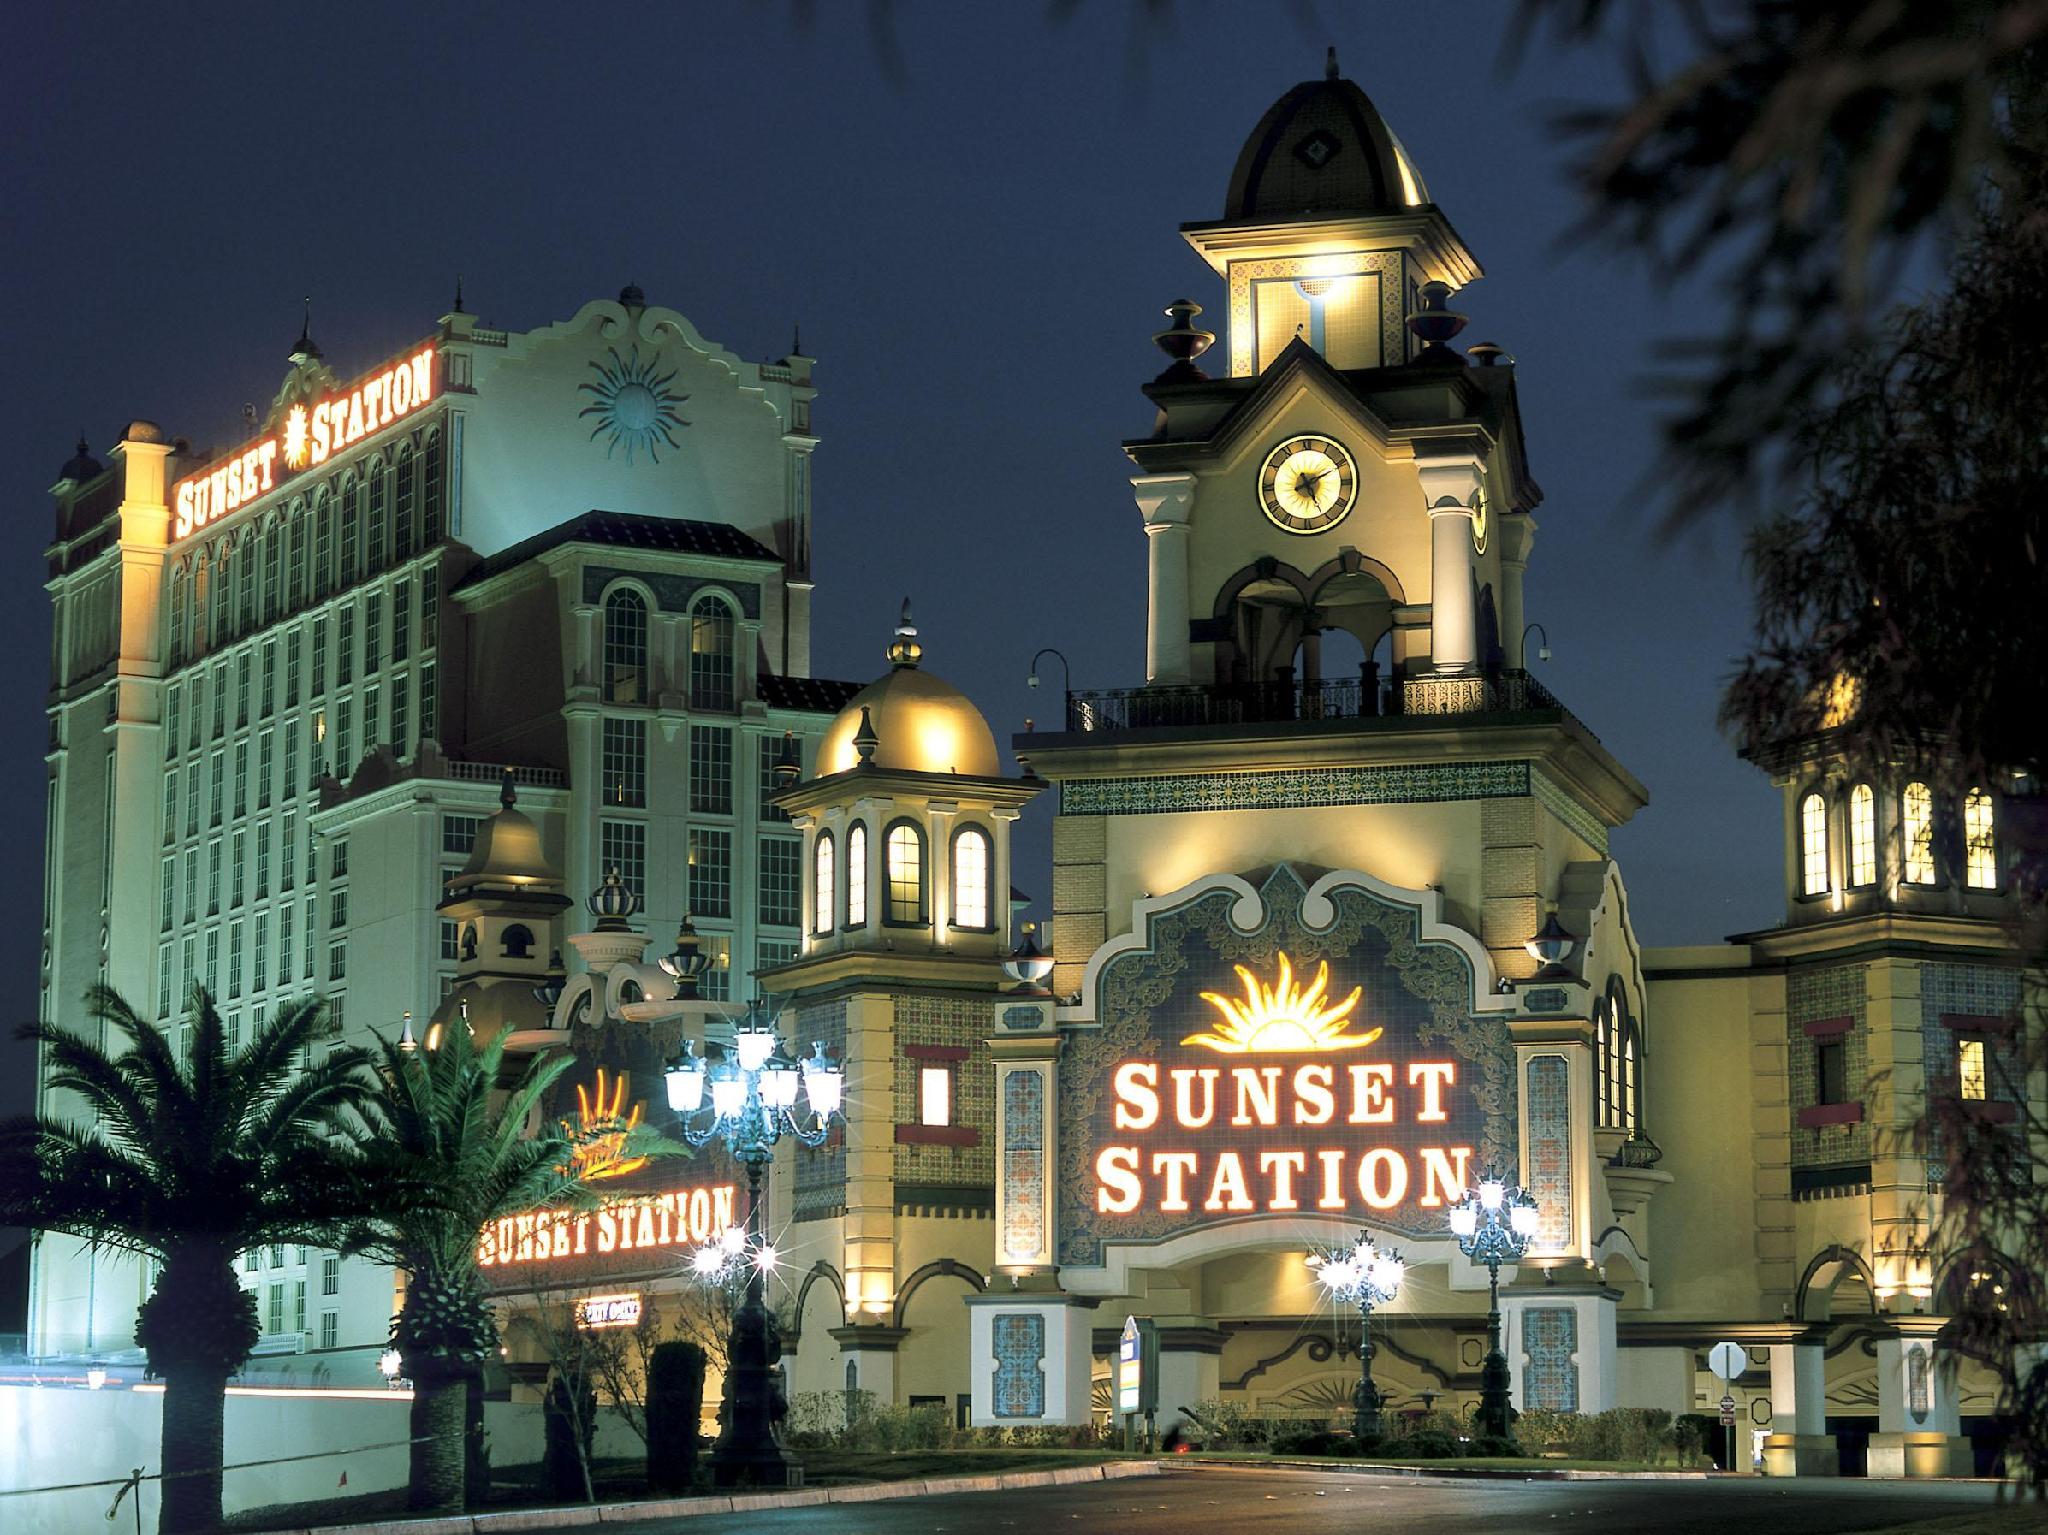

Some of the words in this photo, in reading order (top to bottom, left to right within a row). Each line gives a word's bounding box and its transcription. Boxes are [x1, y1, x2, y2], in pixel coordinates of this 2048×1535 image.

[176, 440, 277, 539] SUNSET
[311, 349, 433, 464] STATION
[1113, 1062, 1454, 1130] SUNSET
[1096, 1146, 1471, 1213] STATION
[479, 1210, 590, 1266] SUNSET
[597, 1185, 735, 1252] STATION
